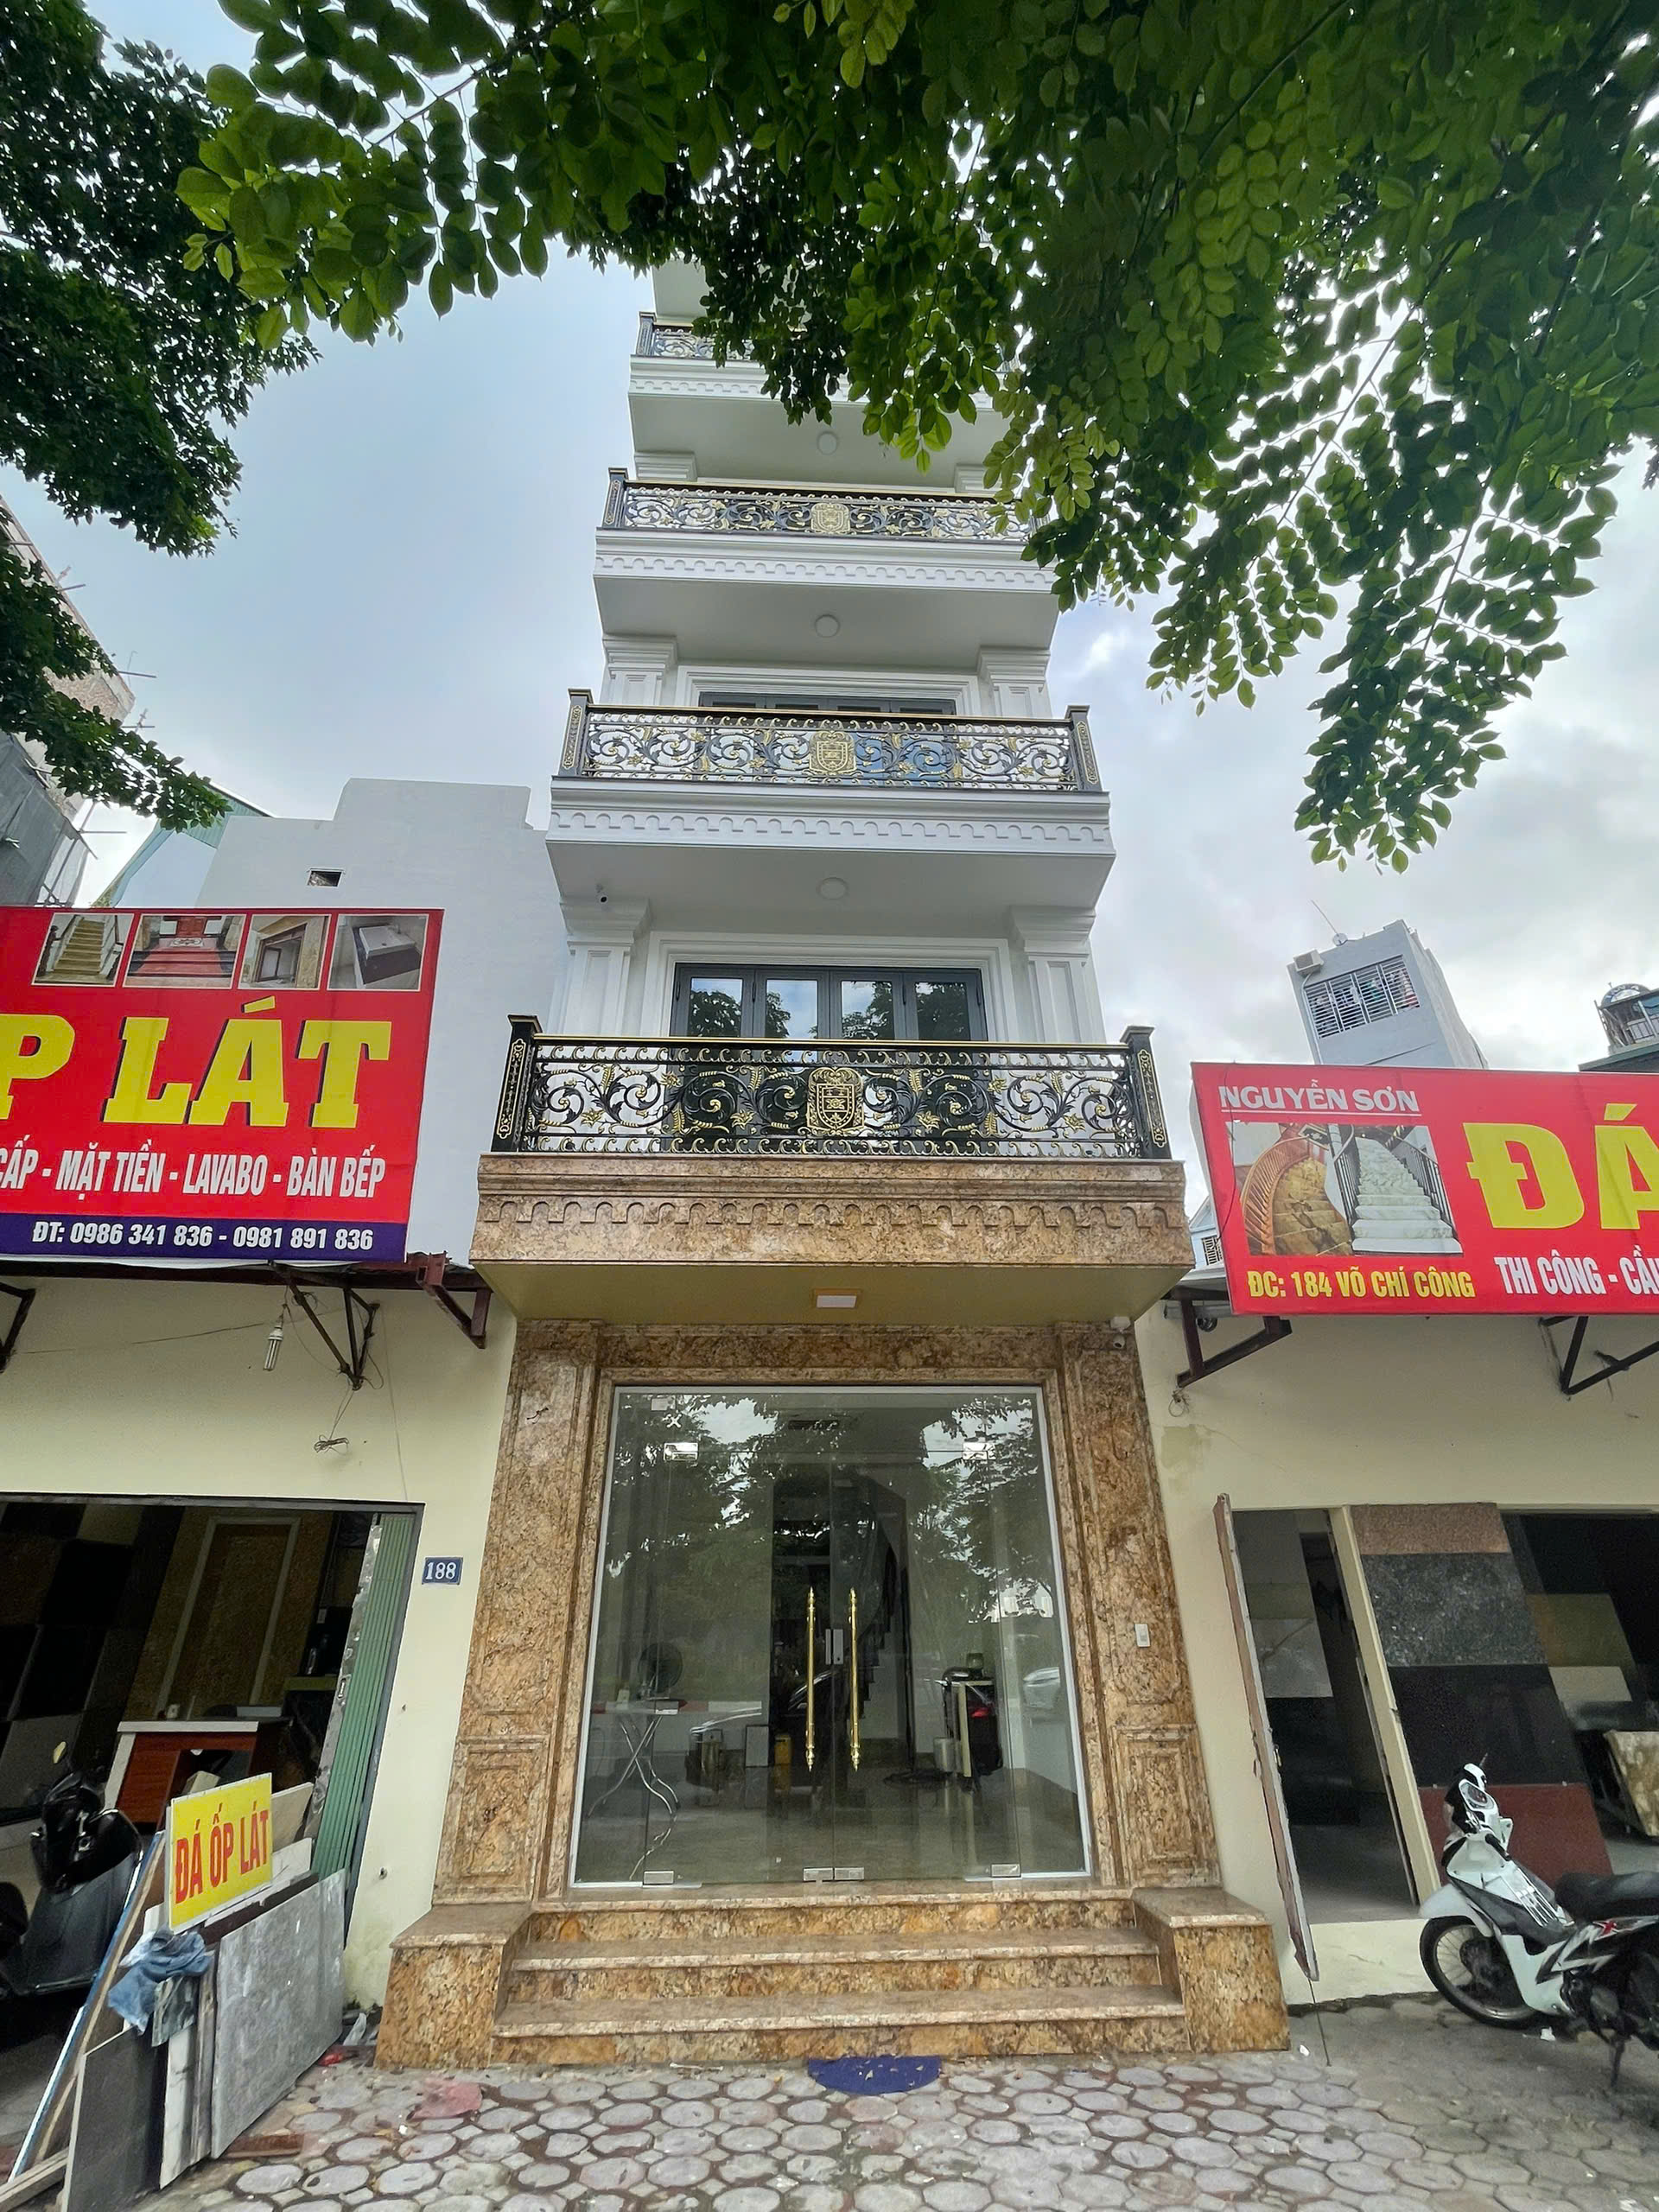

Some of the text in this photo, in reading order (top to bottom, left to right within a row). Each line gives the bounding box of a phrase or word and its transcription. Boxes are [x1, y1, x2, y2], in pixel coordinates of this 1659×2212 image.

[102, 995, 391, 1128] LÁT
[1217, 1079, 1420, 1112] NGUYỄN SƠN
[55, 1142, 111, 1200] MẶT
[112, 1139, 166, 1193] TIỀN
[182, 1154, 268, 1196] LAVABO
[286, 1147, 336, 1197] BÀN
[340, 1144, 385, 1198] BẾP
[1463, 1103, 1659, 1230] ĐÁ
[33, 1222, 65, 1243] ĐT:
[70, 1223, 124, 1244] 0986
[128, 1224, 167, 1245] 341
[173, 1225, 213, 1247] 836
[232, 1226, 283, 1249] 0981
[289, 1228, 327, 1249] 891
[334, 1229, 374, 1250] 836
[1248, 1266, 1477, 1298] ĐC: 184 VÕ CHÍ CÔNG
[1493, 1257, 1539, 1294] THI
[1536, 1249, 1607, 1295] CÔNG
[425, 1562, 456, 1580] 188
[175, 1800, 270, 1904] ĐÁ ỐP LÁT
